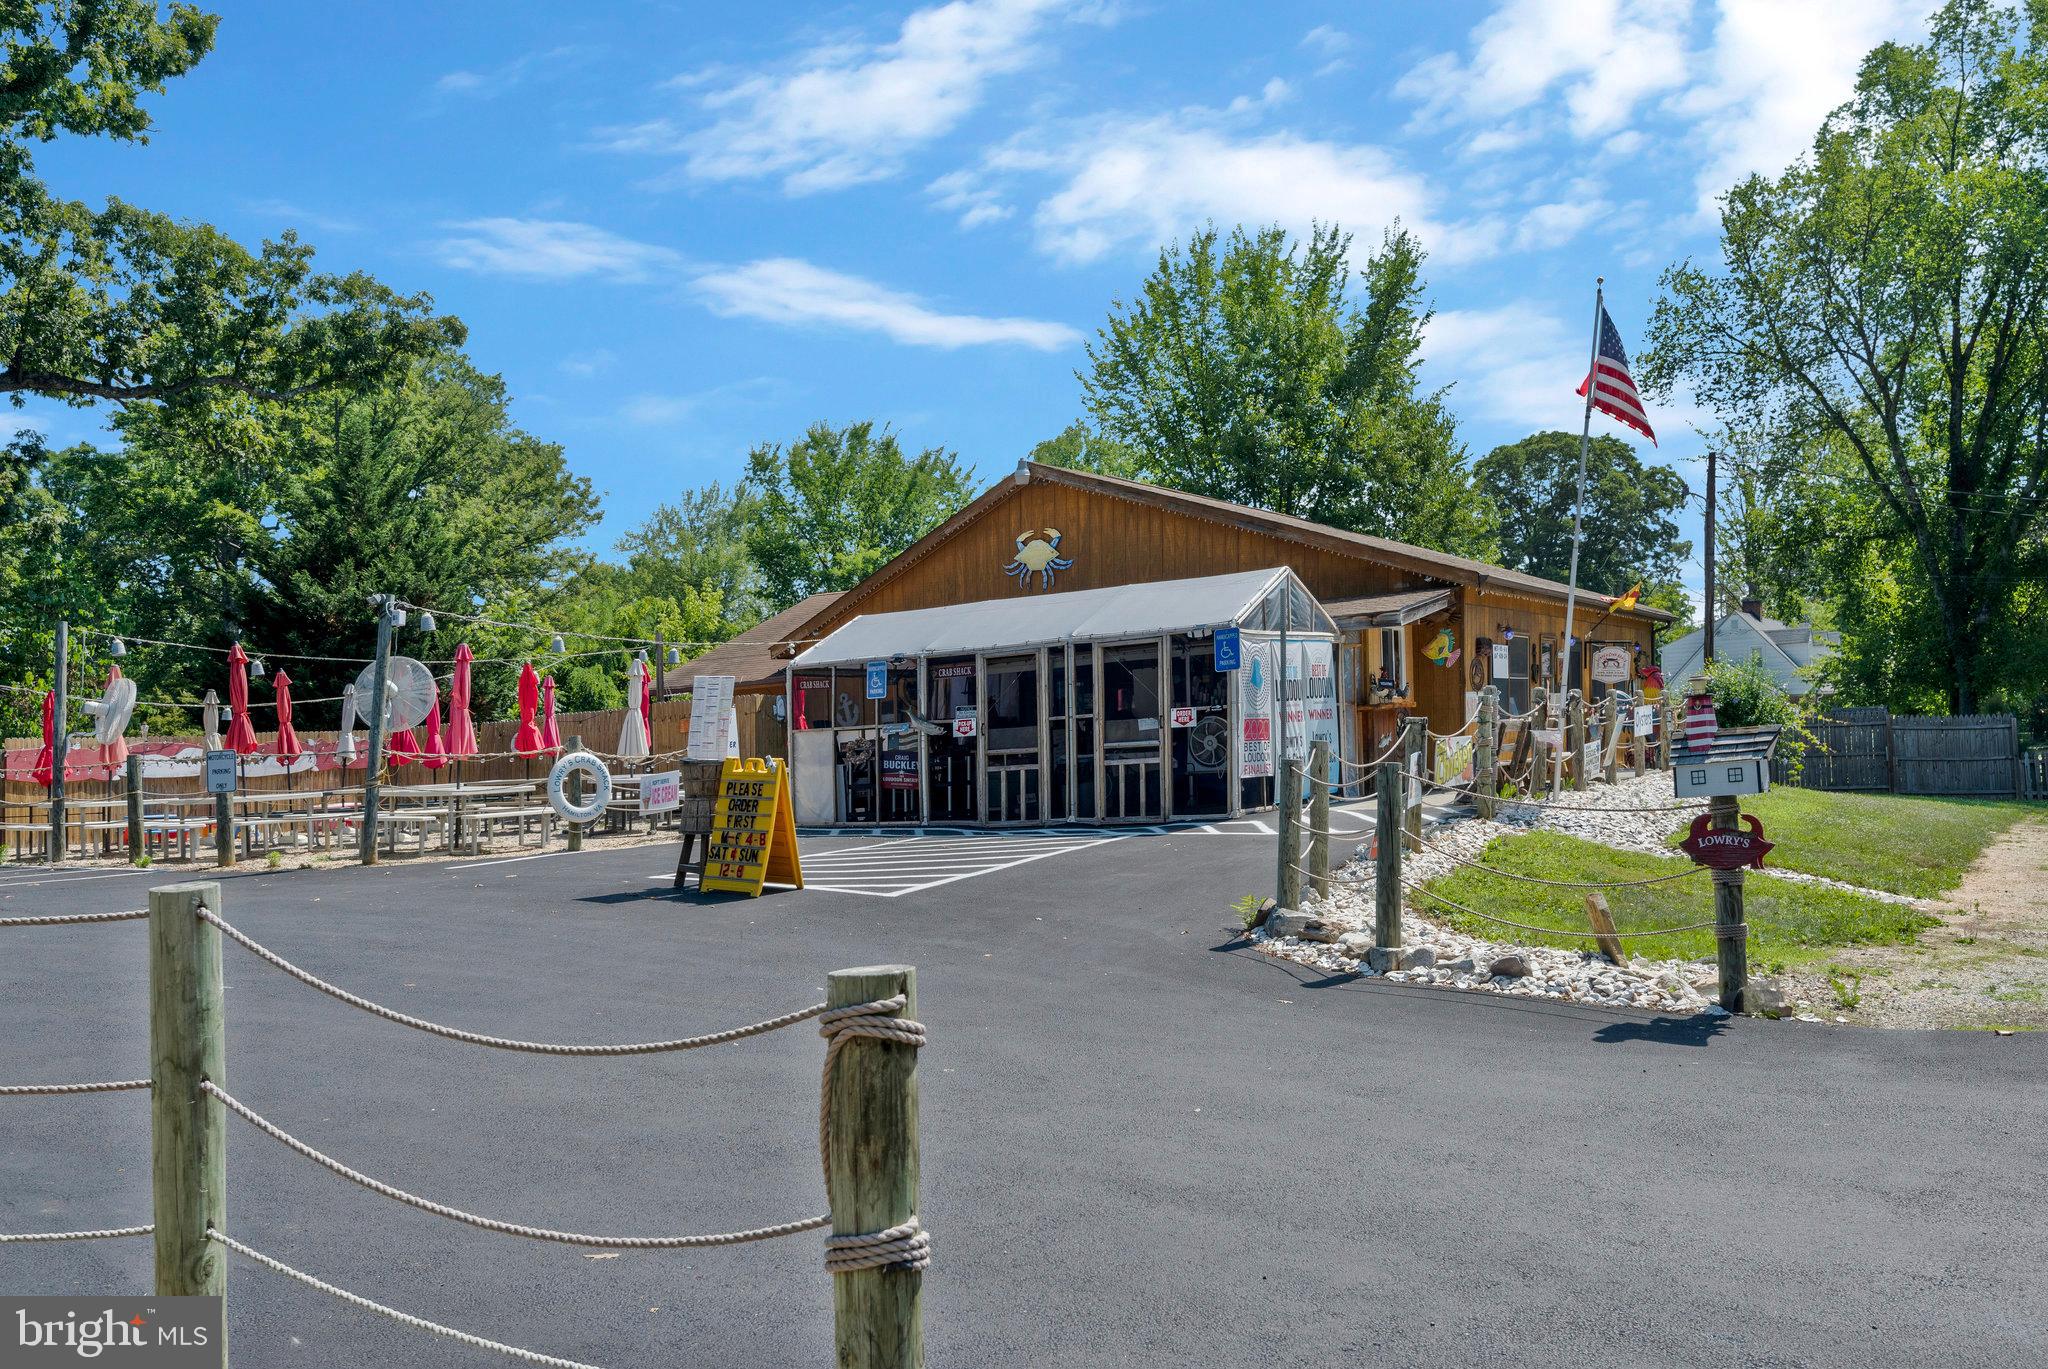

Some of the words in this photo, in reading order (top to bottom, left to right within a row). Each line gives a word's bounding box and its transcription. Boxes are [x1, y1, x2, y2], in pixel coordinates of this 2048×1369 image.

[938, 668, 953, 677] CRAB
[954, 666, 972, 676] SHACK
[1311, 664, 1321, 677] BEST
[800, 681, 813, 689] CRAB
[813, 680, 830, 688] SHACK
[1306, 676, 1333, 699] LOUDOUN
[1308, 708, 1333, 720] WINNER
[1244, 719, 1270, 740] 2020
[1243, 741, 1261, 752] BEST
[208, 753, 234, 761] MOTORCYCLE
[574, 755, 596, 766] CRAB
[595, 763, 610, 791] SHACK
[726, 782, 764, 796] PLEASE
[593, 804, 603, 813] VA
[728, 798, 758, 813] ORDER
[726, 815, 757, 829] FIRST
[1697, 834, 1751, 849] LOWRY'S
[708, 847, 729, 860] SAT
[738, 848, 760, 863] SUN
[720, 863, 745, 878] 12-8
